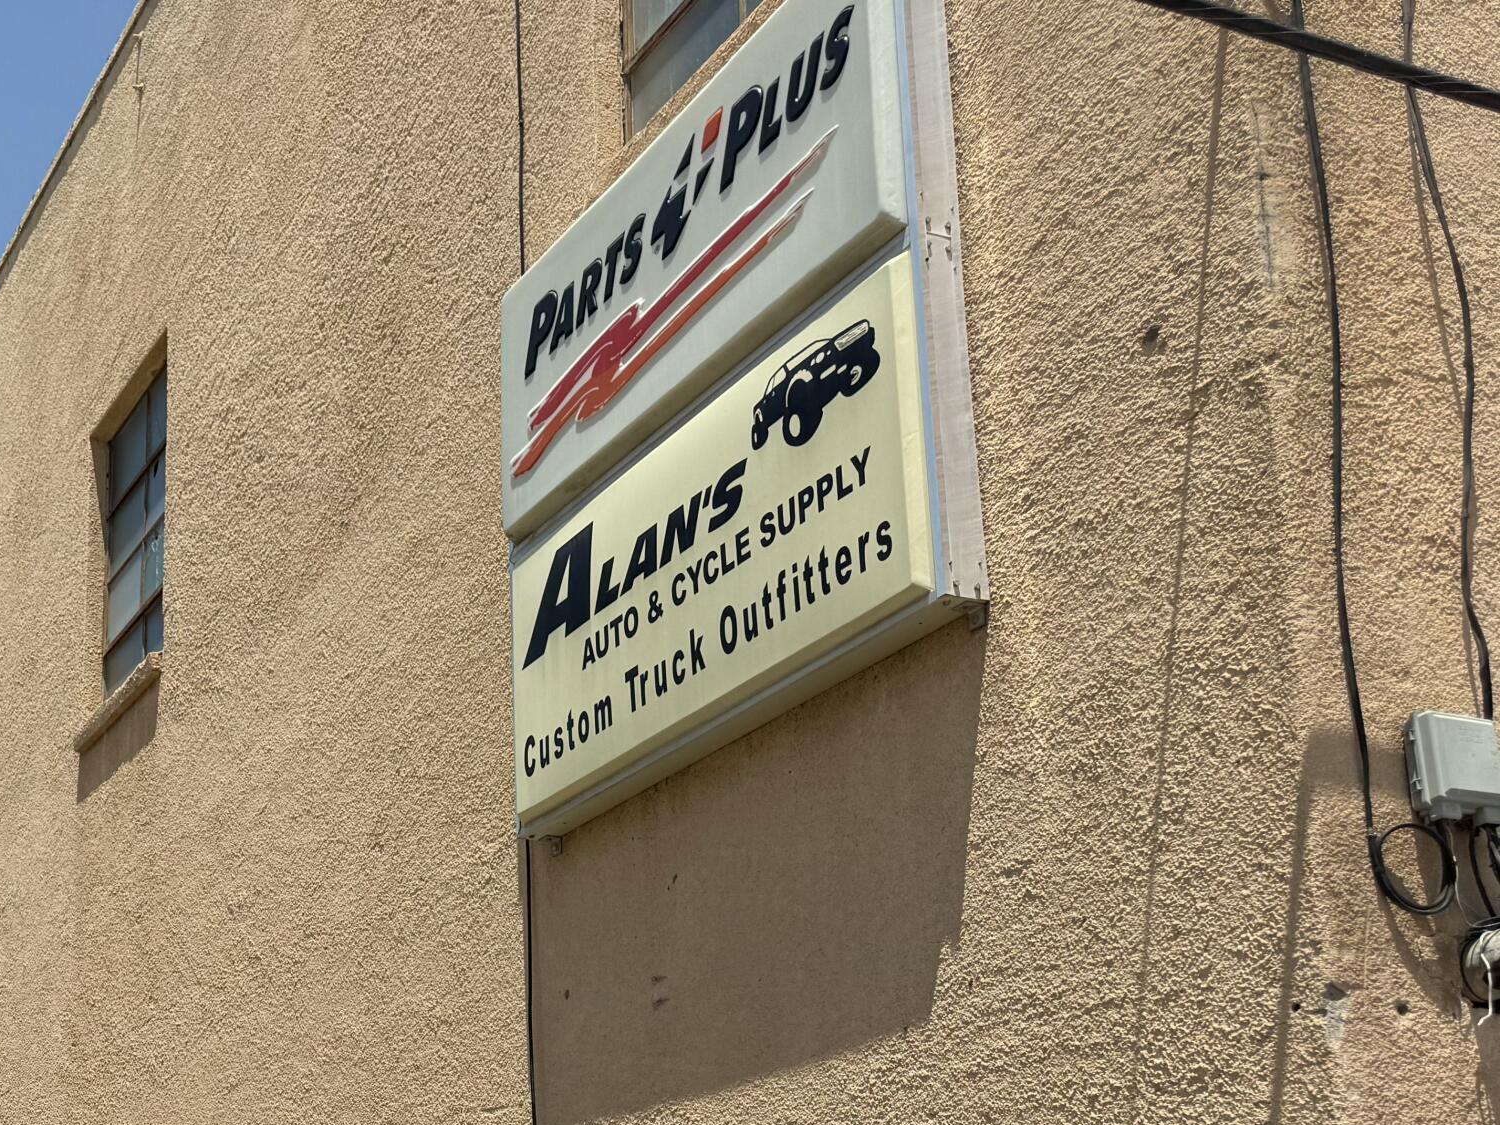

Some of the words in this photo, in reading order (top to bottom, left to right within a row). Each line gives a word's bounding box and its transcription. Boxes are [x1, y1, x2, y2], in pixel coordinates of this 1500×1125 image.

[524, 213, 647, 380] PARTS
[719, 4, 855, 195] PLUS
[522, 457, 748, 670] ALAN'S
[524, 695, 613, 778] Custom
[624, 628, 706, 712] Truck
[719, 520, 893, 655] Outfitters
[582, 606, 639, 671] AUTO
[647, 590, 664, 624] &
[671, 527, 752, 607] CYCLE
[760, 446, 871, 548] SUPPLY
